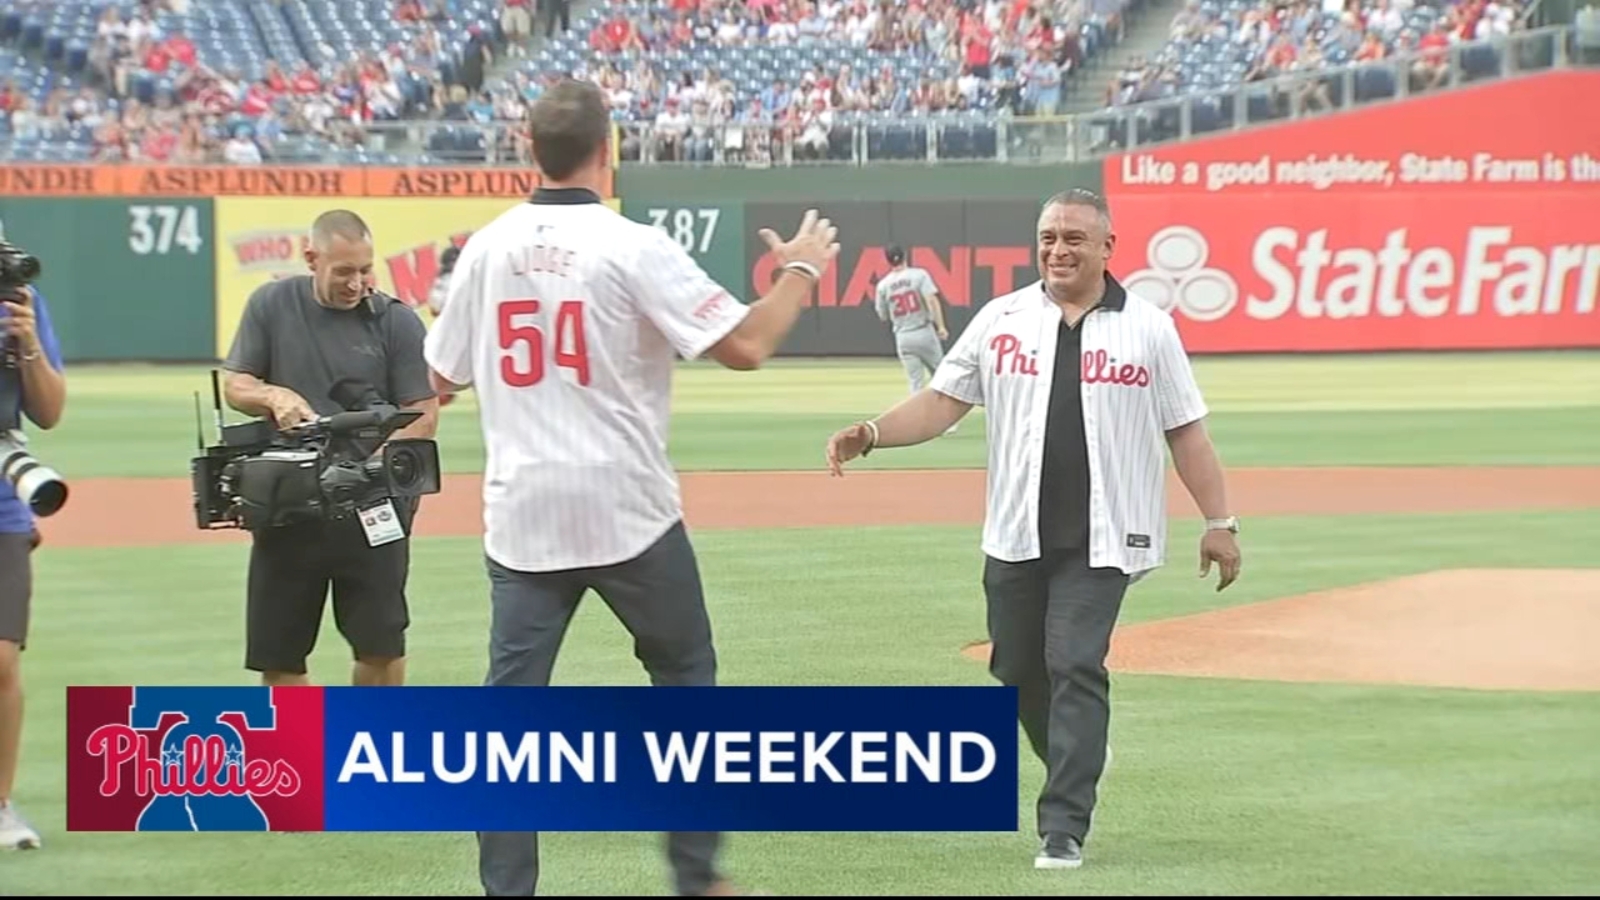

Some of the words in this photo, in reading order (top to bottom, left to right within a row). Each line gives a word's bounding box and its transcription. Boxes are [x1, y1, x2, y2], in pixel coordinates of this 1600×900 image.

[0, 169, 94, 191] NDH
[141, 170, 342, 193] ASPLUNDH
[393, 171, 543, 194] ASPLUN
[1122, 155, 1176, 184] Like
[1182, 162, 1199, 184] a
[1207, 155, 1271, 191] good
[1276, 154, 1395, 190] neighbor,
[1400, 153, 1469, 183] State
[1473, 152, 1539, 182] Farm
[1543, 152, 1567, 182] is
[128, 205, 202, 253] 374
[890, 291, 921, 316] 30
[497, 300, 590, 388] 54
